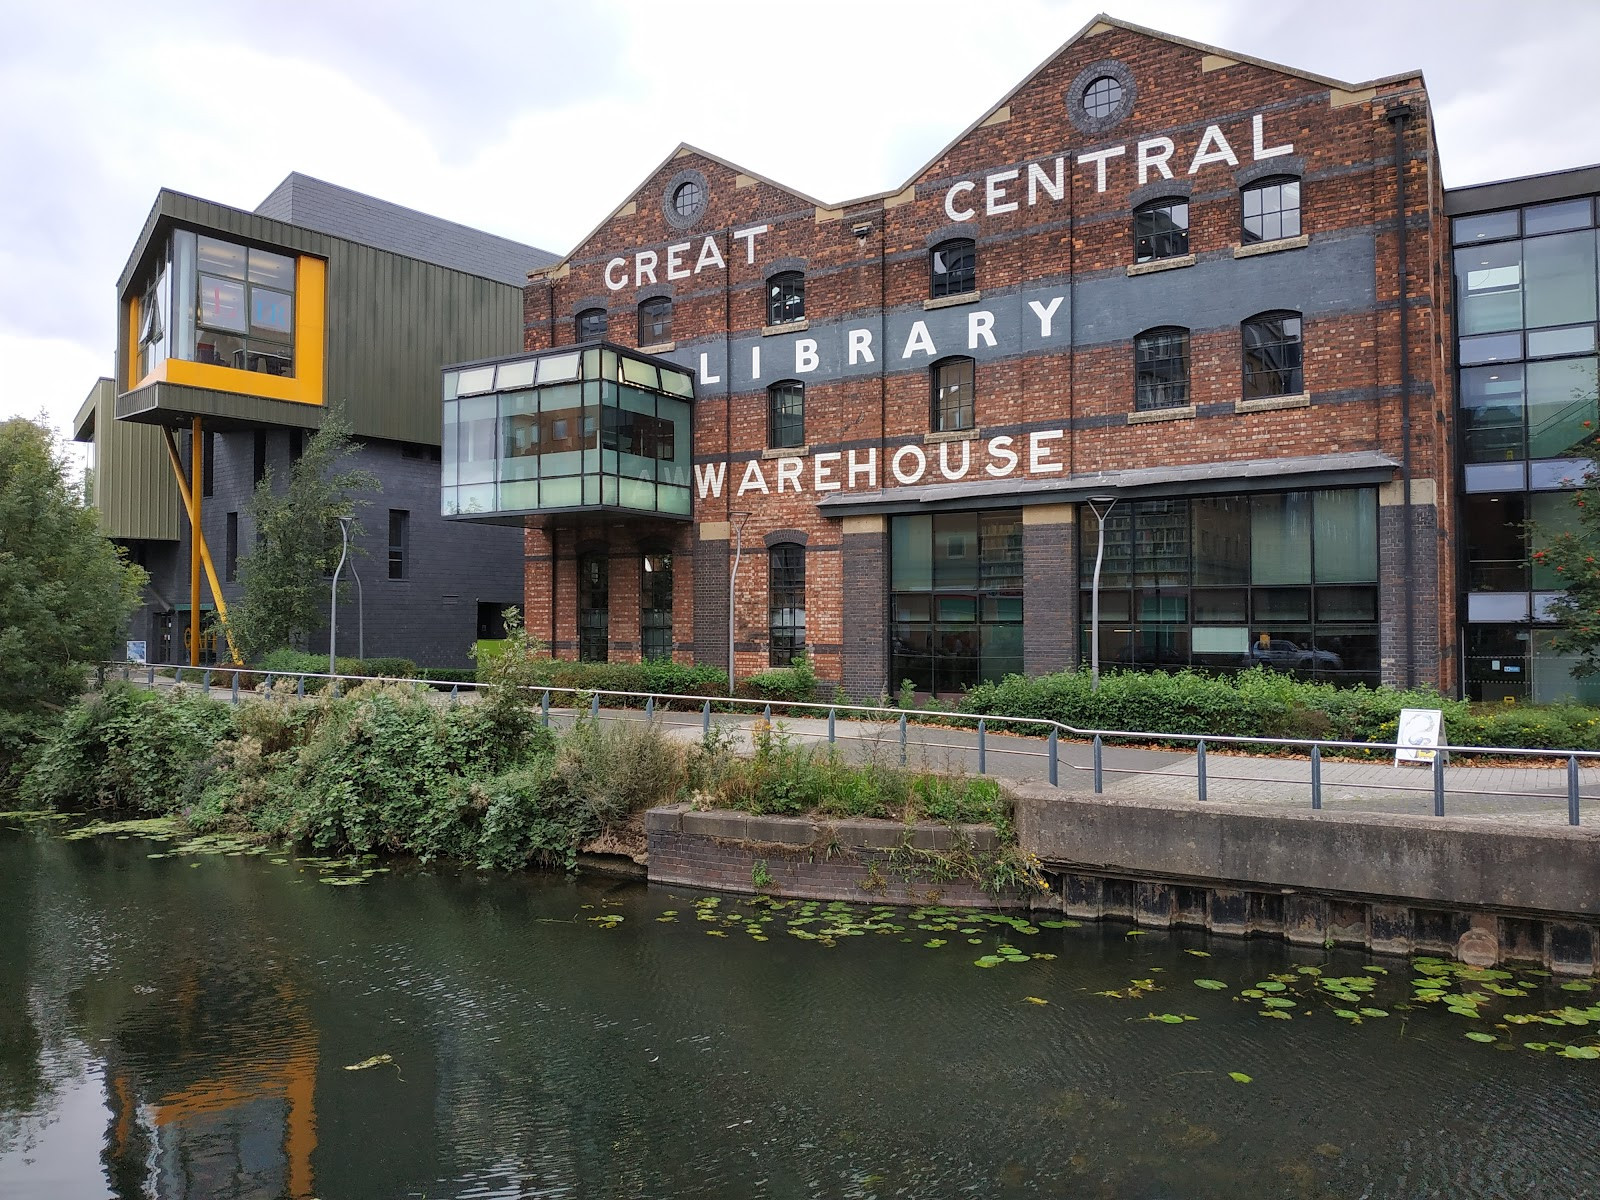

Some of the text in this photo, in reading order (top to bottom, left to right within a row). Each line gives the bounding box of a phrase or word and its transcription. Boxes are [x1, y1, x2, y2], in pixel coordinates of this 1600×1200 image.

[605, 115, 1293, 290] GREAT CENTRAL
[701, 297, 1064, 384] LIBRARY
[694, 429, 1063, 498] WAREHOUSE
